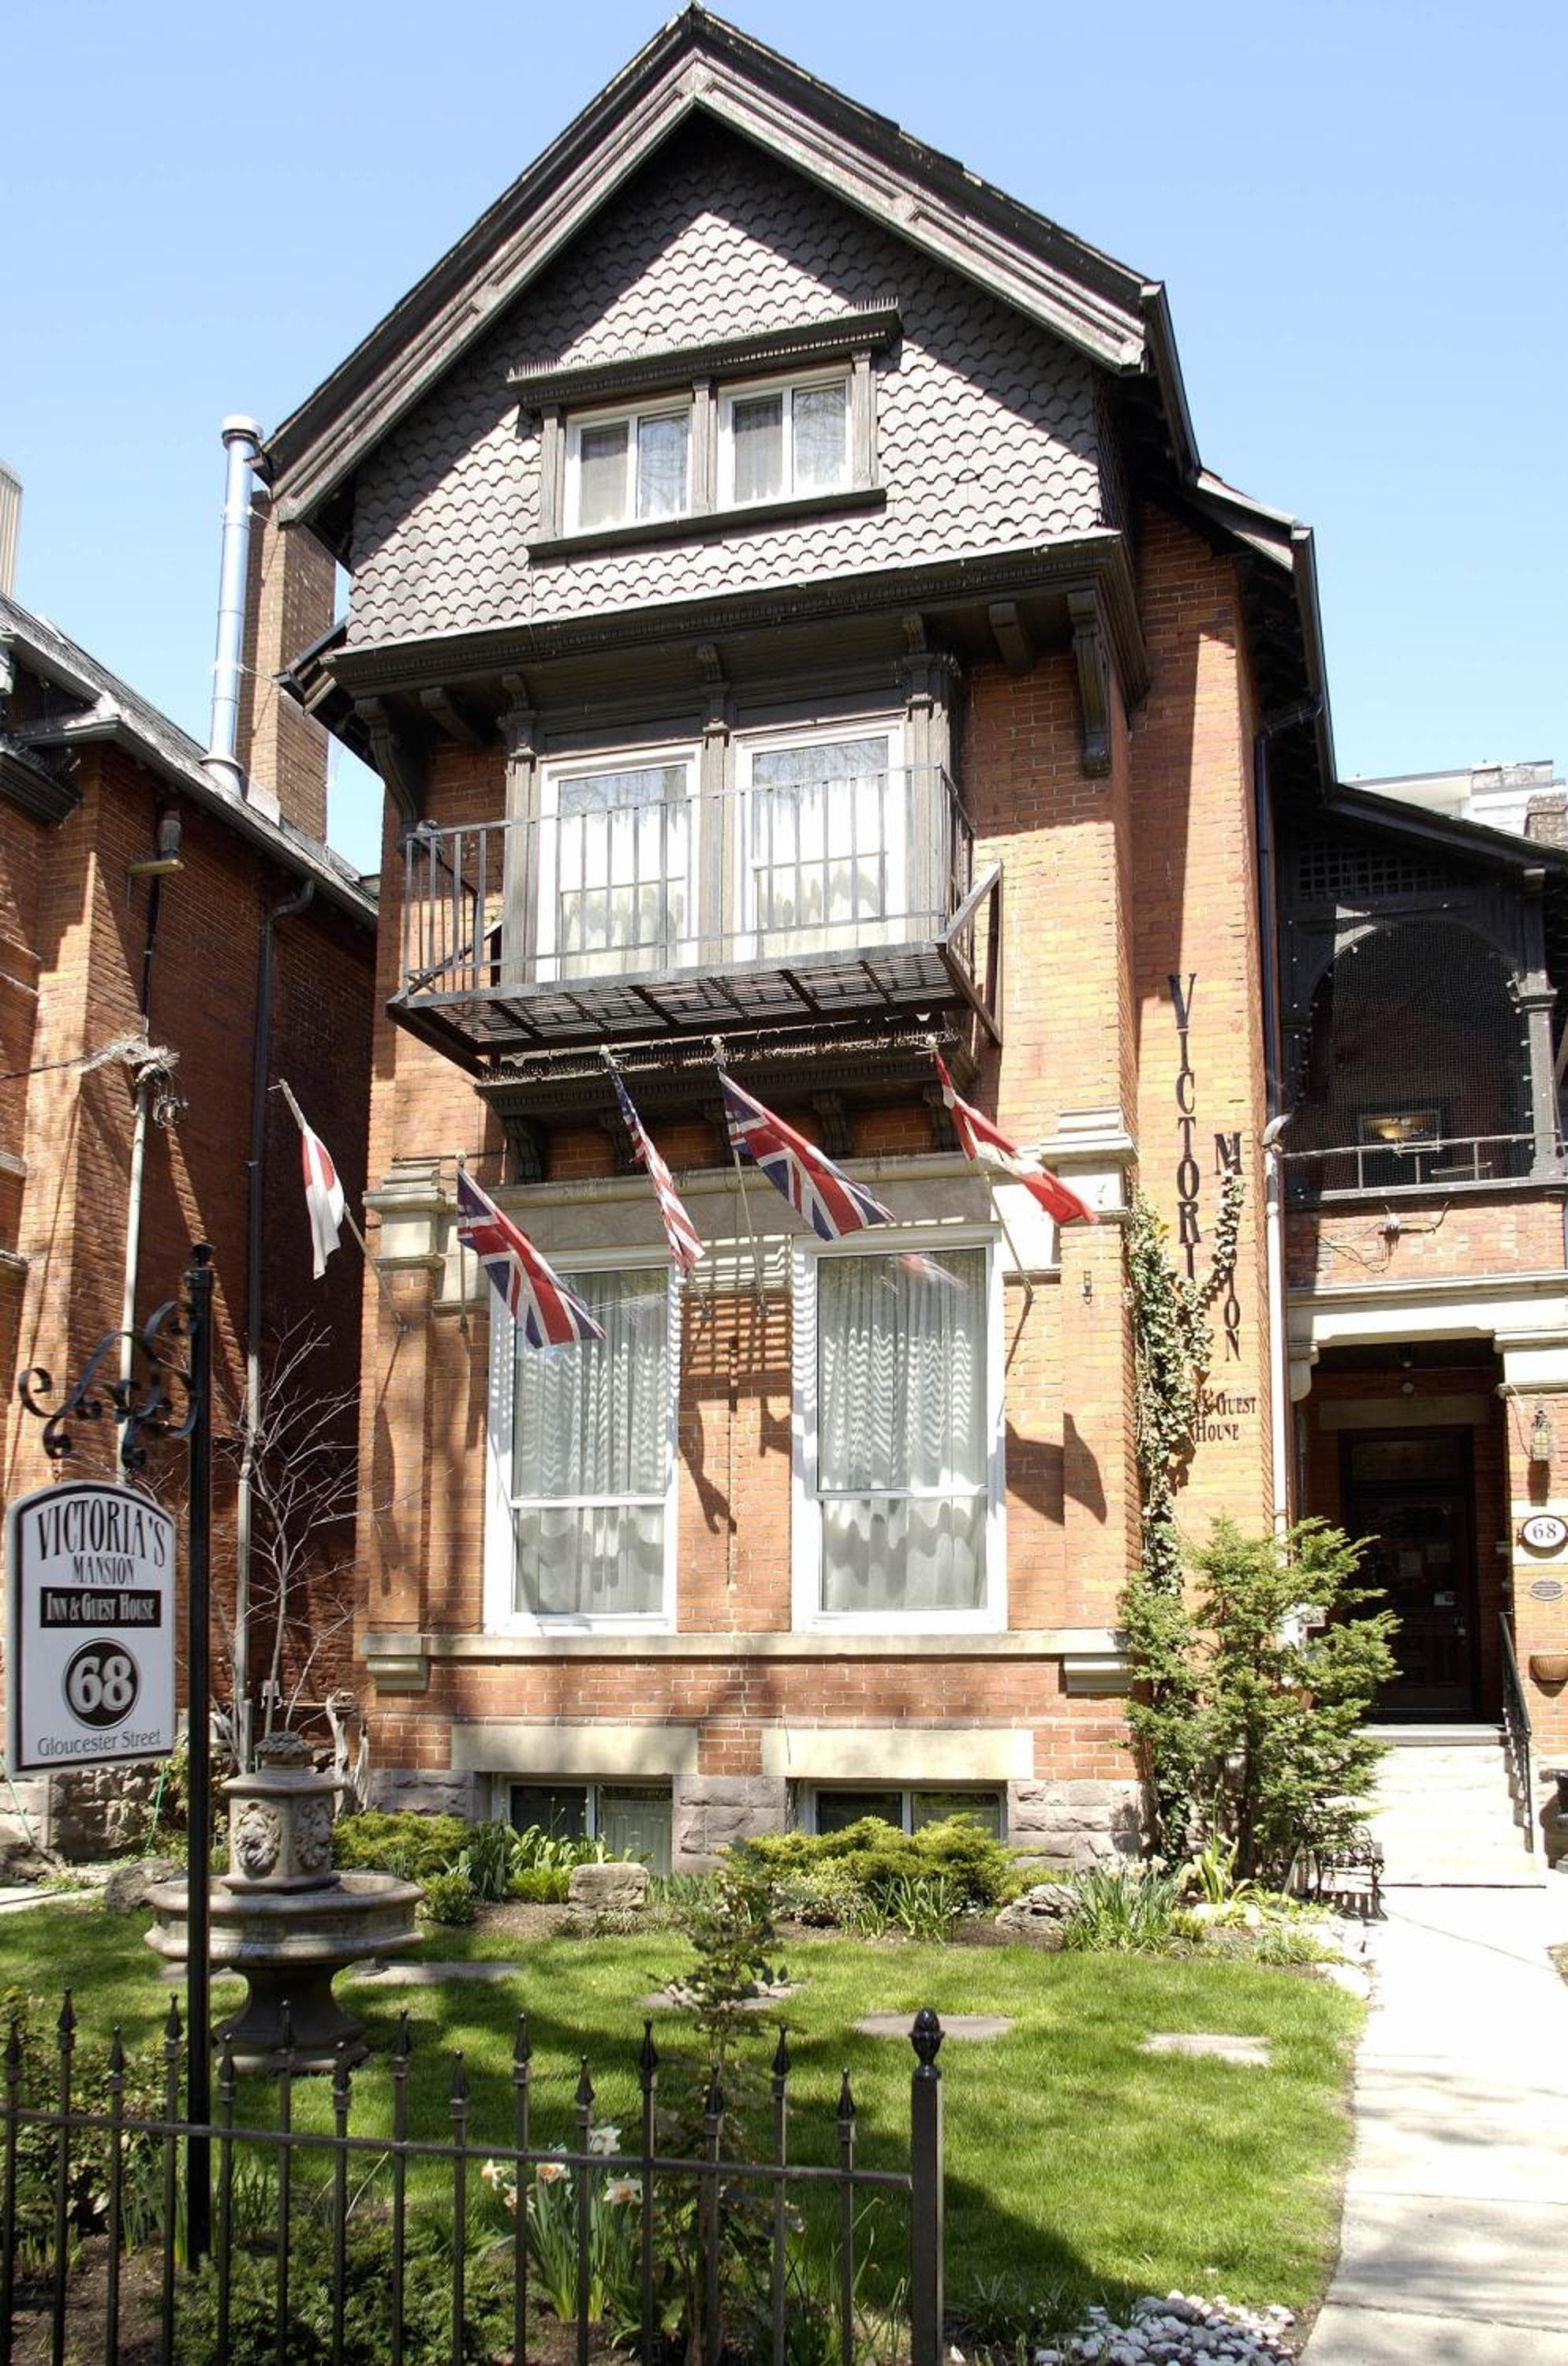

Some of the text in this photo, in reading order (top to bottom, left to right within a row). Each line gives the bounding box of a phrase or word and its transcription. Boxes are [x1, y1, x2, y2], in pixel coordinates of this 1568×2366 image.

[1167, 972, 1200, 1282] VICTORI
[1214, 1133, 1242, 1362] MION
[1215, 1392, 1256, 1416] GUEST
[1194, 1419, 1240, 1442] HOUSE
[37, 1498, 166, 1568] VICTORIA'S
[1533, 1522, 1557, 1540] 68
[72, 1555, 135, 1584] MANSION
[46, 1592, 155, 1621] INN & GUEST HOUSE
[69, 1655, 133, 1714] 68
[37, 1729, 161, 1756] Gloucester Street
